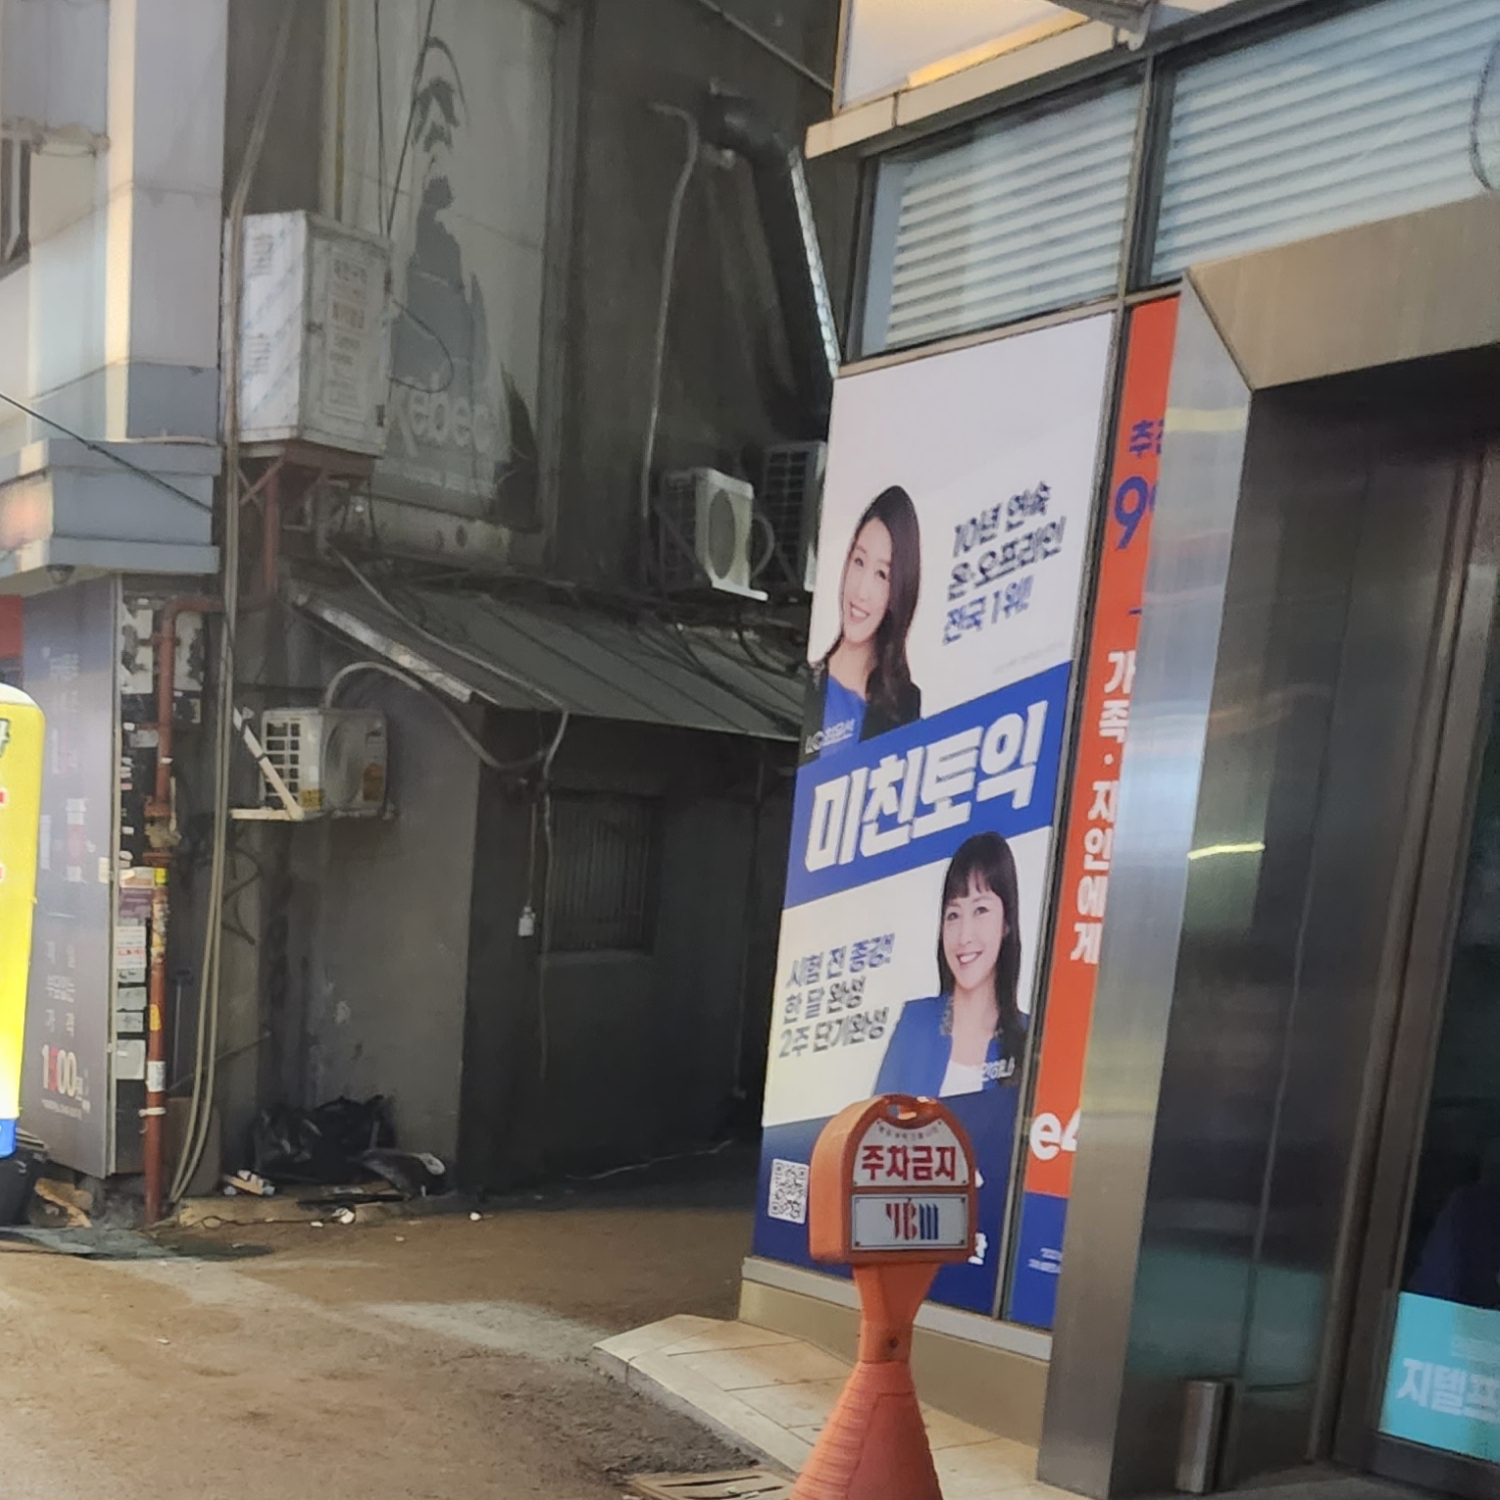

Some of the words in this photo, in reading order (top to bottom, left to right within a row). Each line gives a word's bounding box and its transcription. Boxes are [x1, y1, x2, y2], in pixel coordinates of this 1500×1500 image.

[952, 501, 1002, 559] 10년
[1004, 480, 1052, 533] 연속
[1113, 475, 1156, 551] 9
[941, 596, 987, 647] 전국
[804, 700, 1049, 873] 미친토익
[785, 951, 825, 989] 시험
[826, 945, 847, 980] 전
[825, 975, 867, 1016] 완성
[778, 1025, 811, 1059] 2주
[812, 1006, 890, 1053] 단기완성
[861, 1144, 957, 1182] 주차금지
